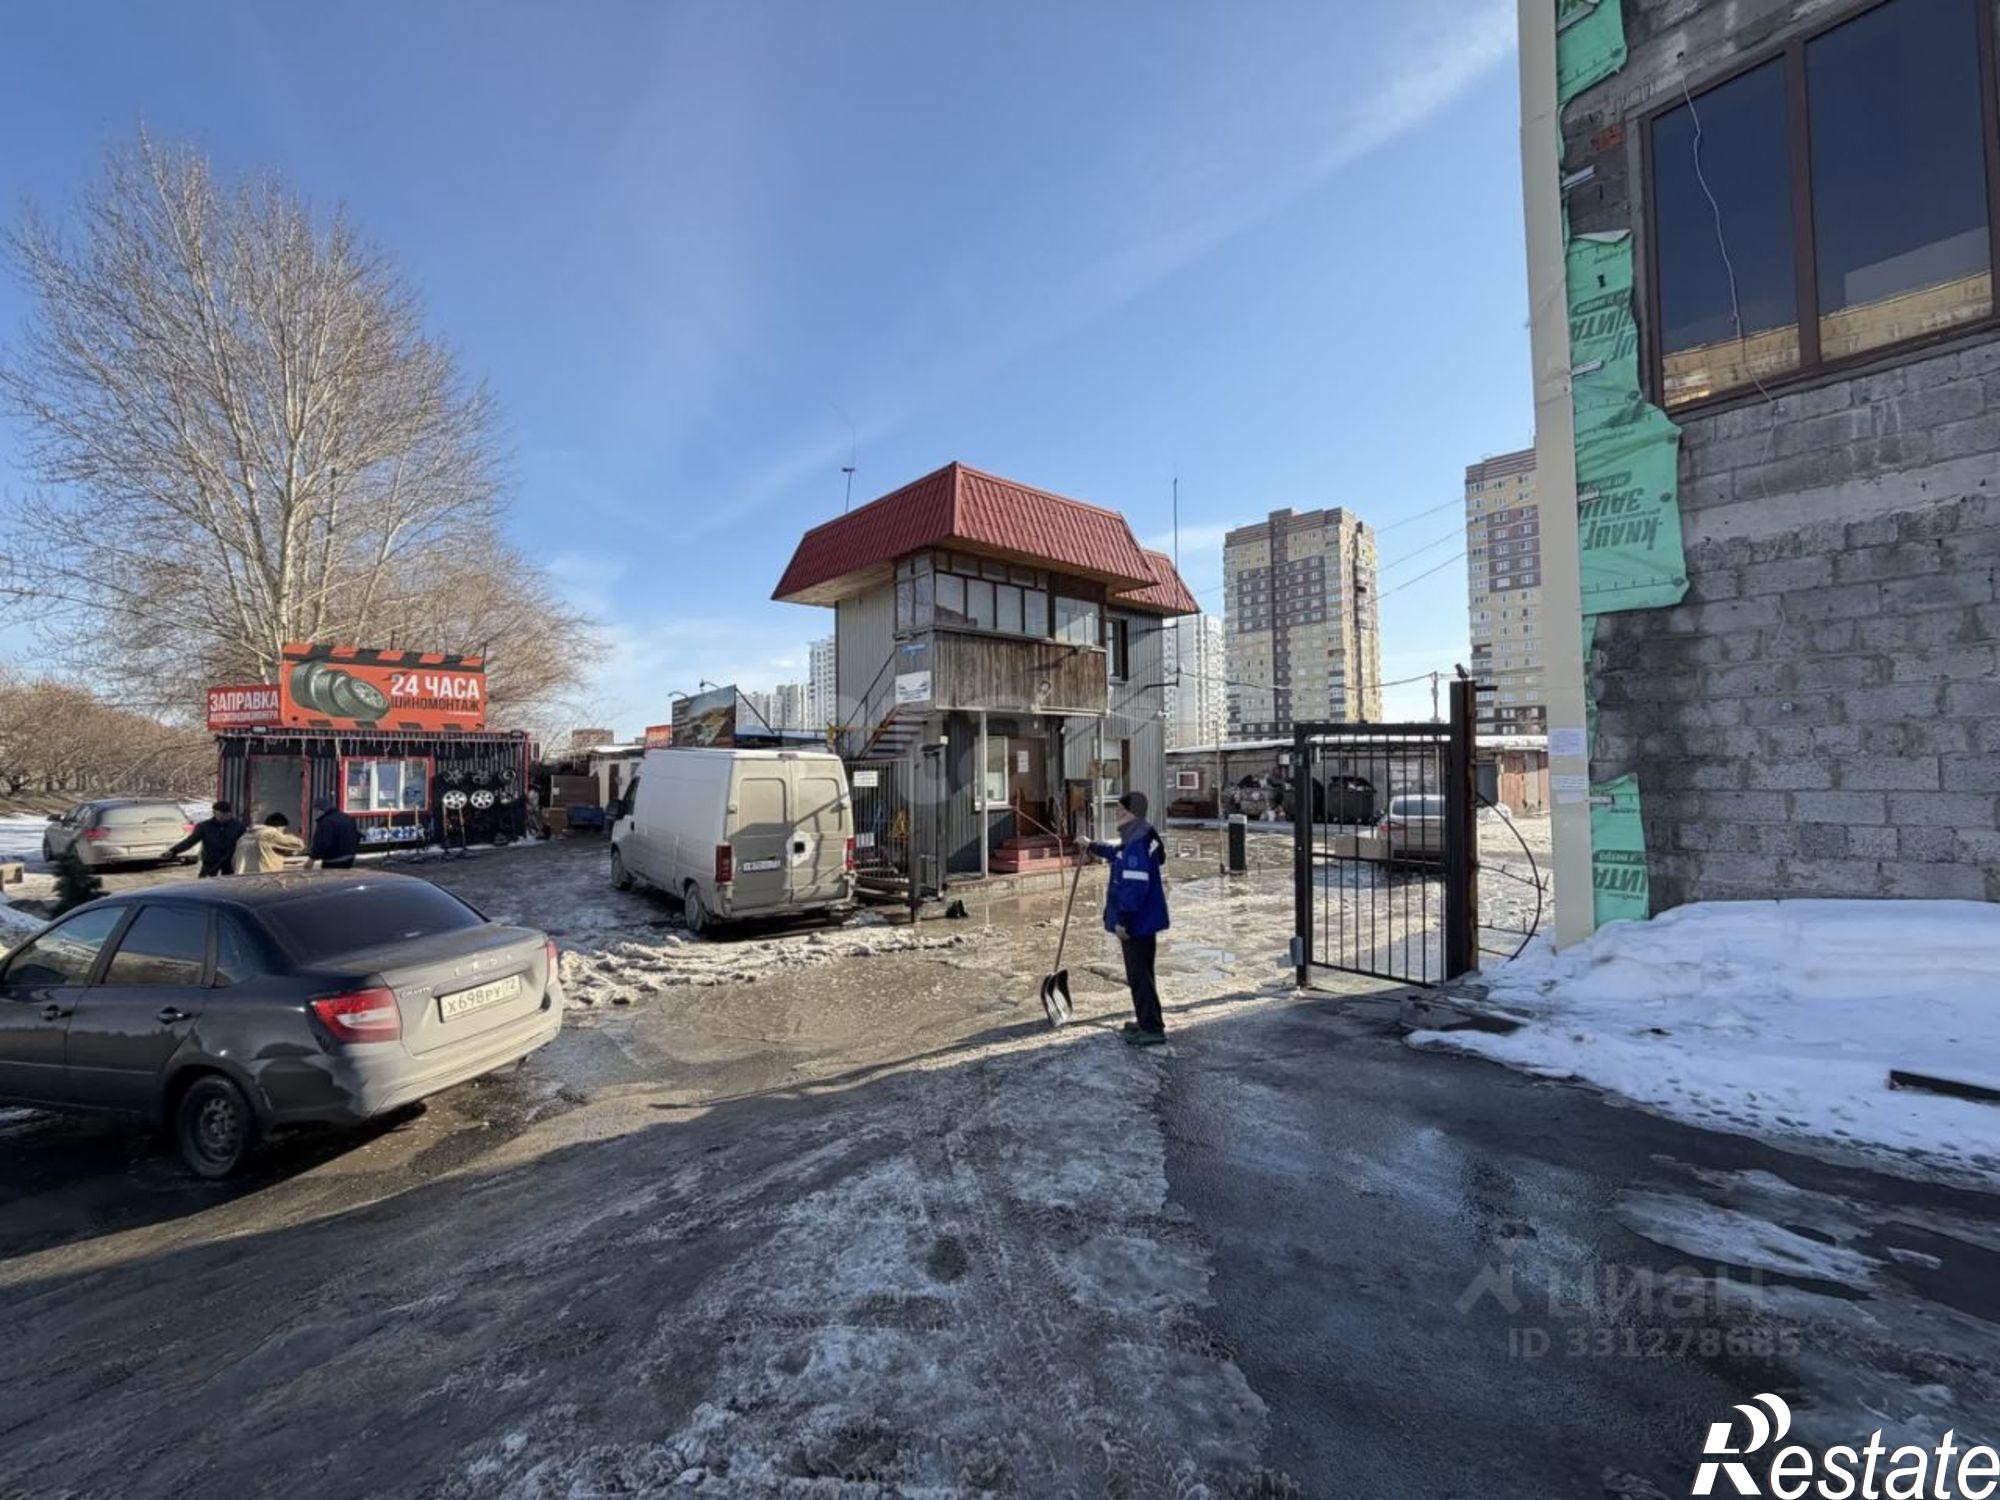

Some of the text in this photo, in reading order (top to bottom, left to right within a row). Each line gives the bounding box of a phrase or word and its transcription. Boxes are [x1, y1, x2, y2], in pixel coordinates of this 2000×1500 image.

[391, 674, 480, 700] 24 ЧАСА
[209, 690, 279, 712] ЗАПРАВКА
[391, 695, 480, 712] ШИНОМОНТАЖ
